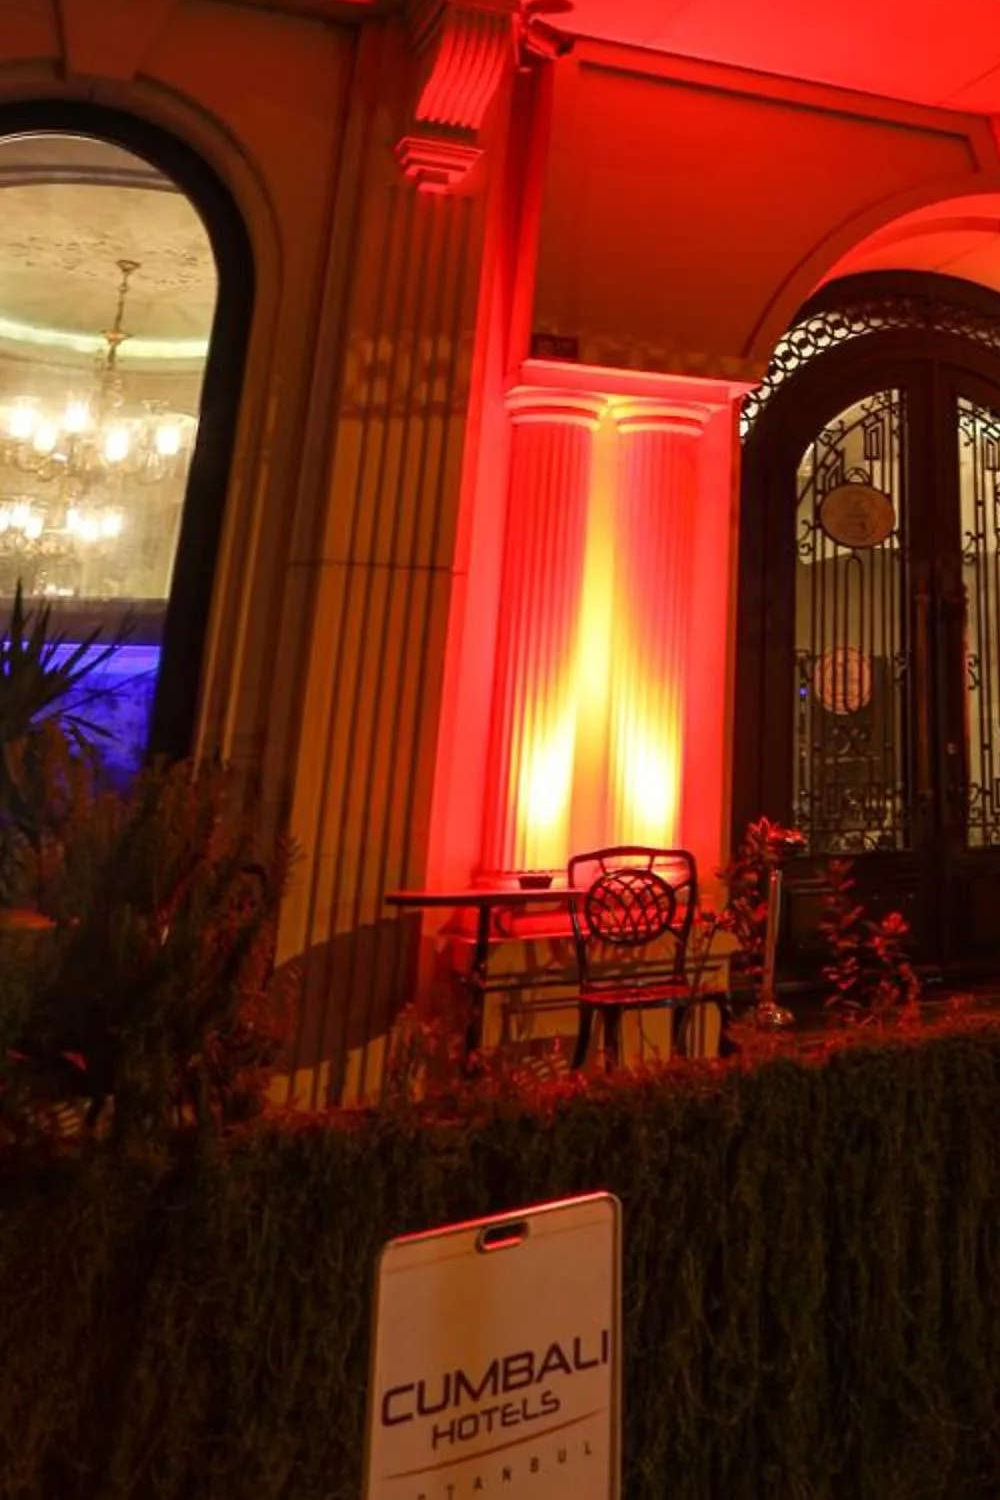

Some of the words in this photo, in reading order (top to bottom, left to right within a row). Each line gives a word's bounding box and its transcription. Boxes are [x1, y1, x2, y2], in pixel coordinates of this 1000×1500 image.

[382, 1329, 609, 1426] CUMBALI
[431, 1389, 561, 1450] HOTELS
[417, 1441, 592, 1500] TANBUL
